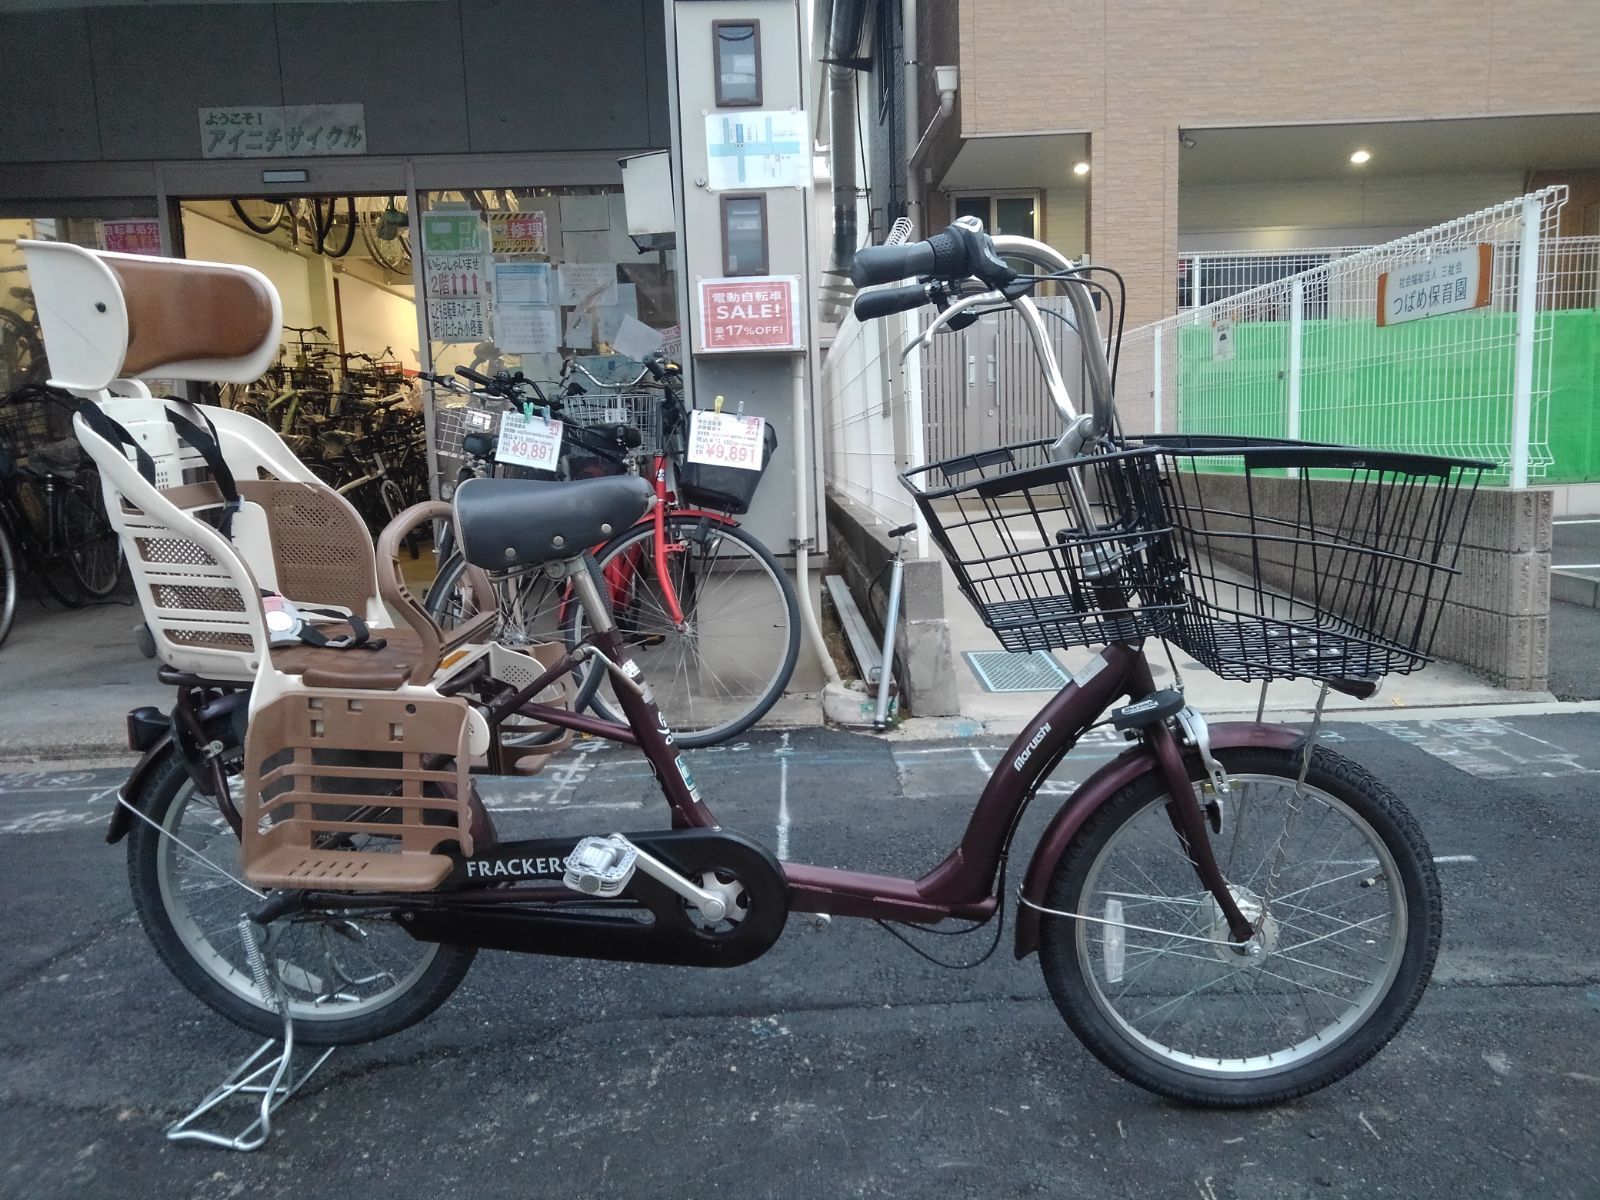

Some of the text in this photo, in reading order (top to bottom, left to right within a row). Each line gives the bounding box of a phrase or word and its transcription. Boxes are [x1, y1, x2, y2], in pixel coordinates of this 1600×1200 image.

[427, 257, 480, 271] いらっしゃいませ
[712, 291, 783, 304] 電動自転車
[1393, 277, 1467, 314] つばめ保育園
[716, 303, 781, 320] SALE!
